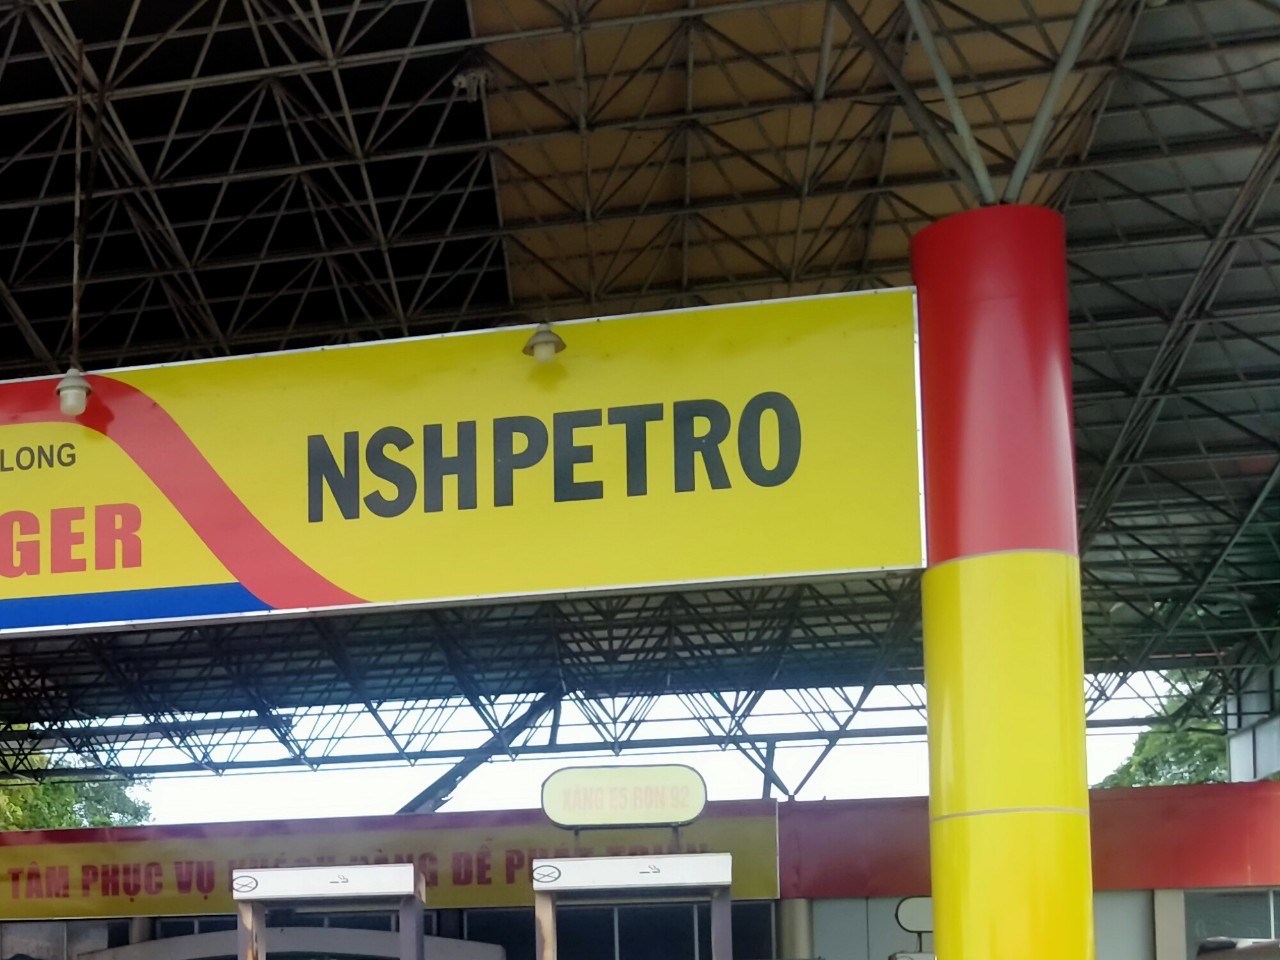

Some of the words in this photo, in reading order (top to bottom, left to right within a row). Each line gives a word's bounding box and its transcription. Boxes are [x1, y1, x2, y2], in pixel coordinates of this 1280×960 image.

[0, 442, 77, 472] LONG
[308, 391, 802, 523] NSHPETRO
[82, 862, 163, 902] PHỤC
[174, 860, 215, 899] VỤ
